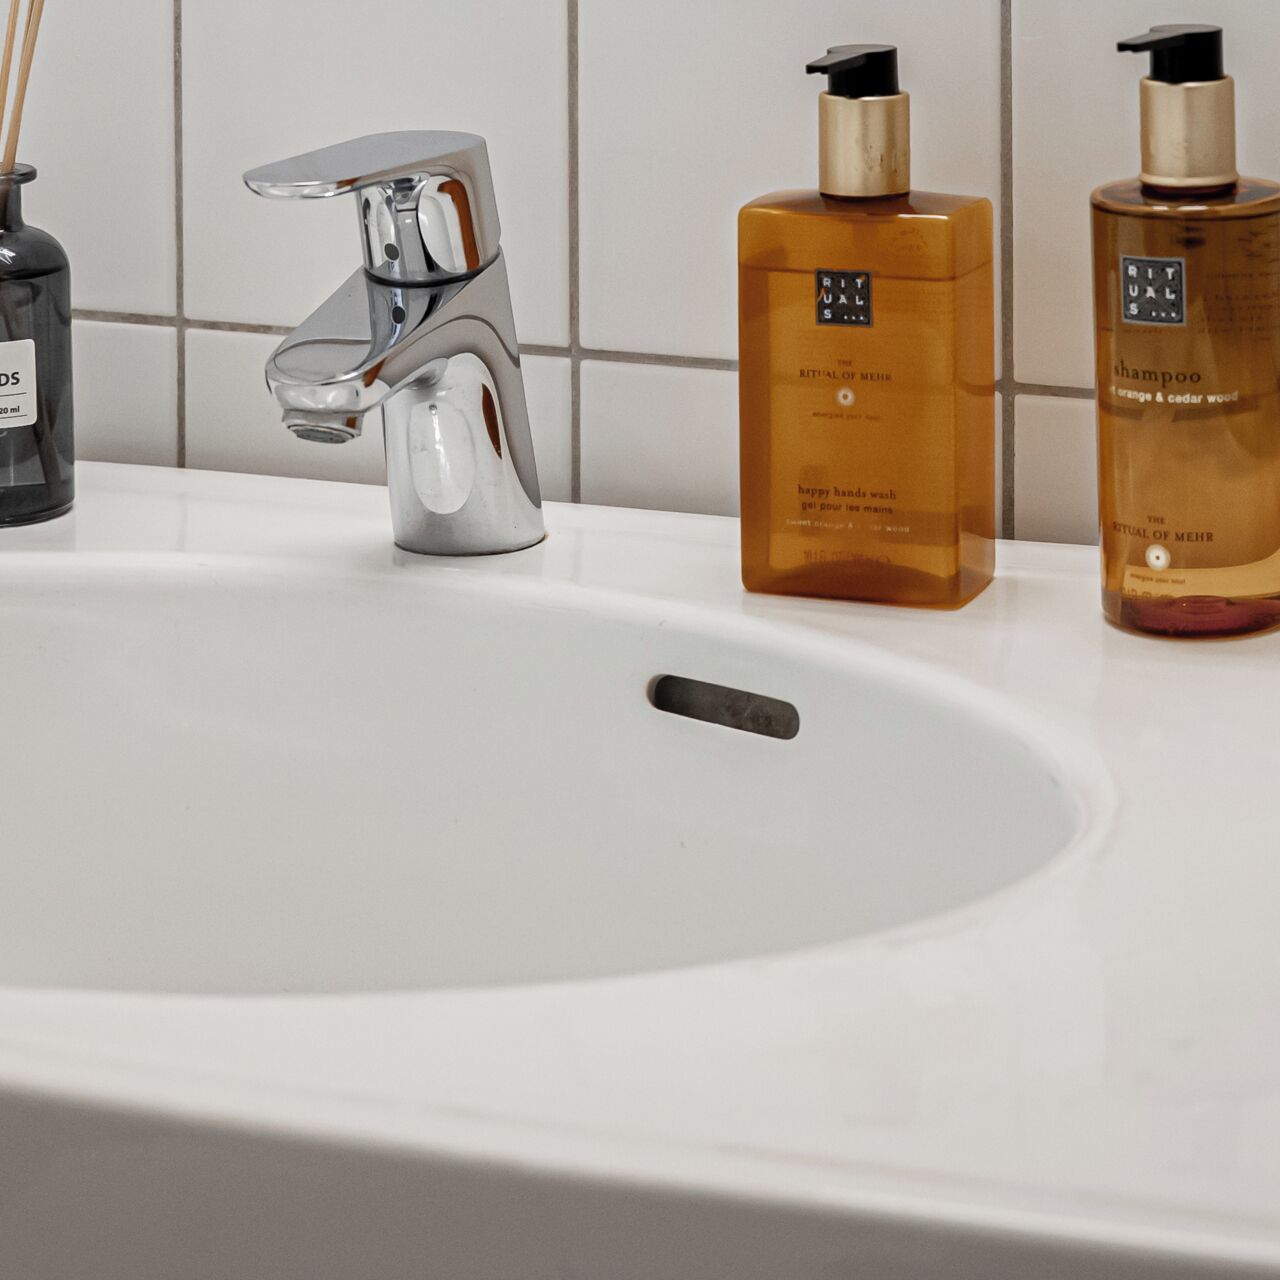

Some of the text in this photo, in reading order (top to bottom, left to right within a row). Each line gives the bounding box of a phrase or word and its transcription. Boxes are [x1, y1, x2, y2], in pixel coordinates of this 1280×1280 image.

[799, 369, 894, 382] RITUAL OF MEHR
[1114, 360, 1202, 388] shampoo
[1117, 389, 1153, 403] orange
[1155, 392, 1164, 403] &
[1167, 393, 1203, 404] cedar
[1206, 390, 1239, 404] wood
[9, 405, 21, 413] ml
[797, 484, 897, 500] happy hands wash
[801, 500, 894, 514] gel pour les mains
[1147, 515, 1165, 524] THE
[1152, 529, 1169, 541] OF
[1174, 531, 1215, 543] MEHR
